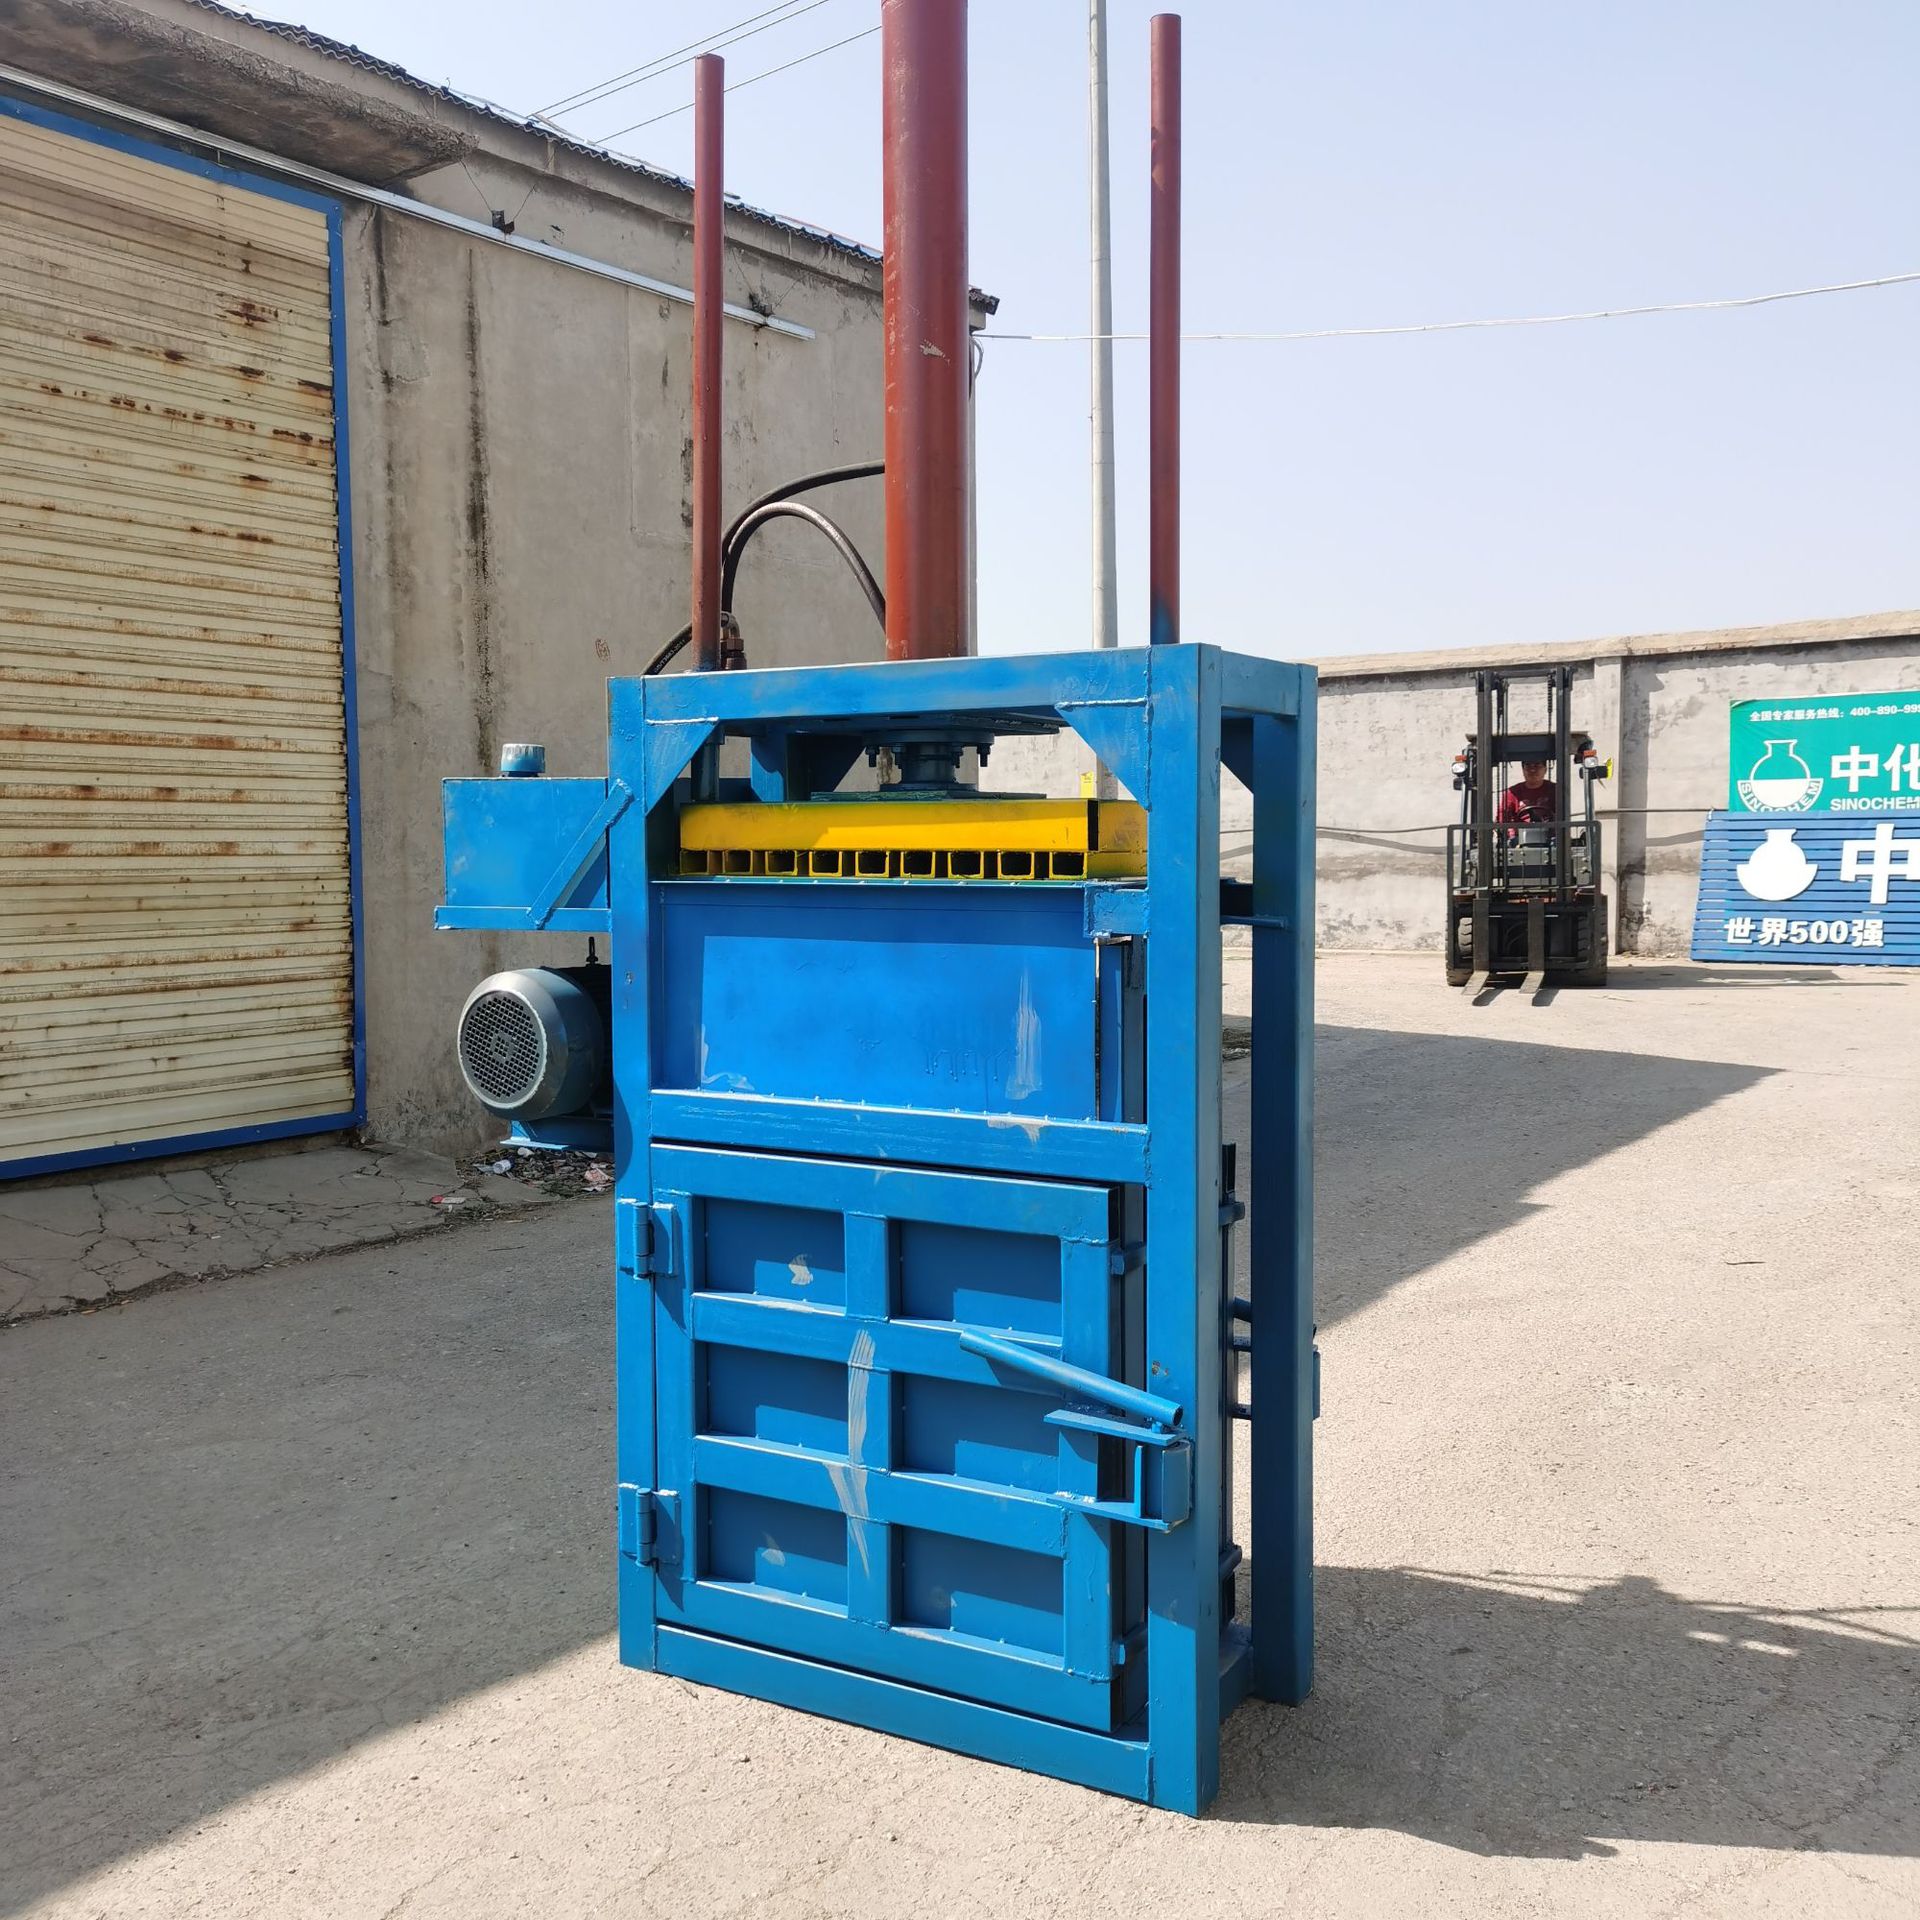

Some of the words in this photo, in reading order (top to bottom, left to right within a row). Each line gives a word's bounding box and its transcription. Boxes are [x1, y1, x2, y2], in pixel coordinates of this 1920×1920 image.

[1831, 743, 1920, 793] 中化
[1830, 796, 1920, 811] SINOCHEM
[1840, 823, 1920, 905] 中
[1724, 917, 1884, 947] 世界500强
